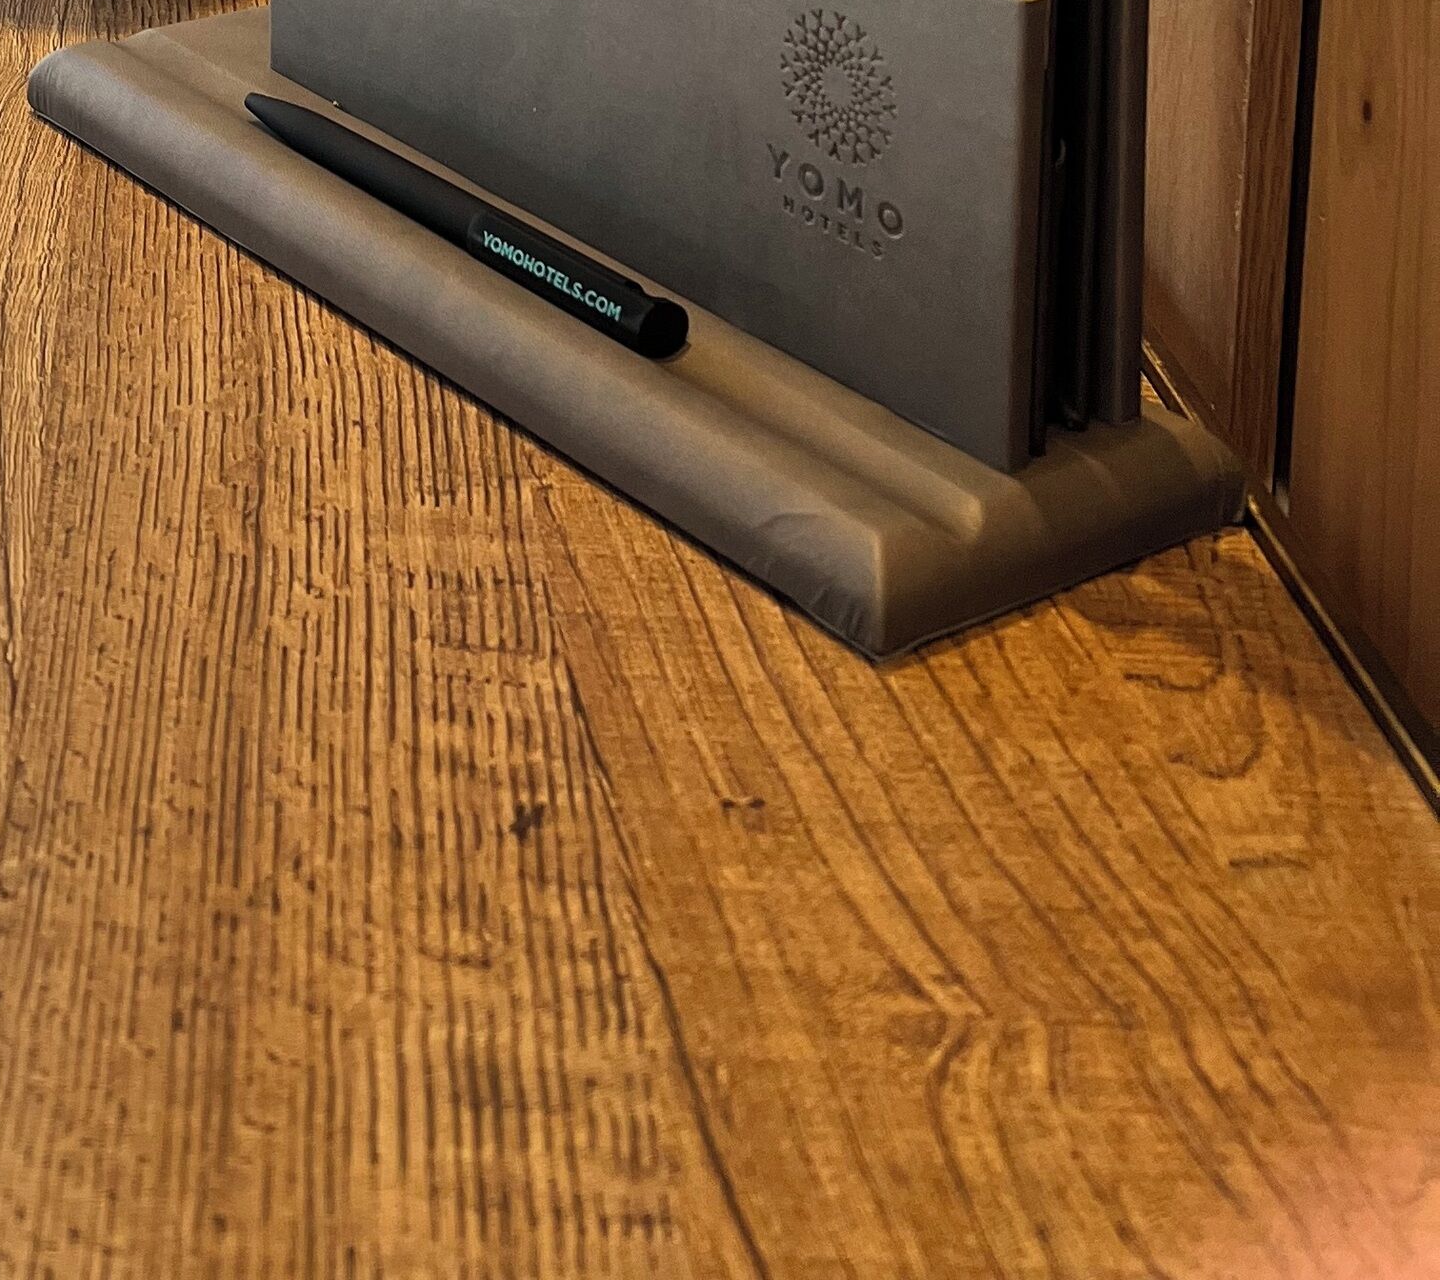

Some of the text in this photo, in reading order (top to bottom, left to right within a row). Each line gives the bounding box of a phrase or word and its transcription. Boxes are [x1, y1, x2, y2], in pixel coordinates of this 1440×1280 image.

[766, 142, 904, 238] YOMO
[782, 194, 884, 260] HOTELS
[482, 230, 622, 323] YOMOHOTELS.COM
